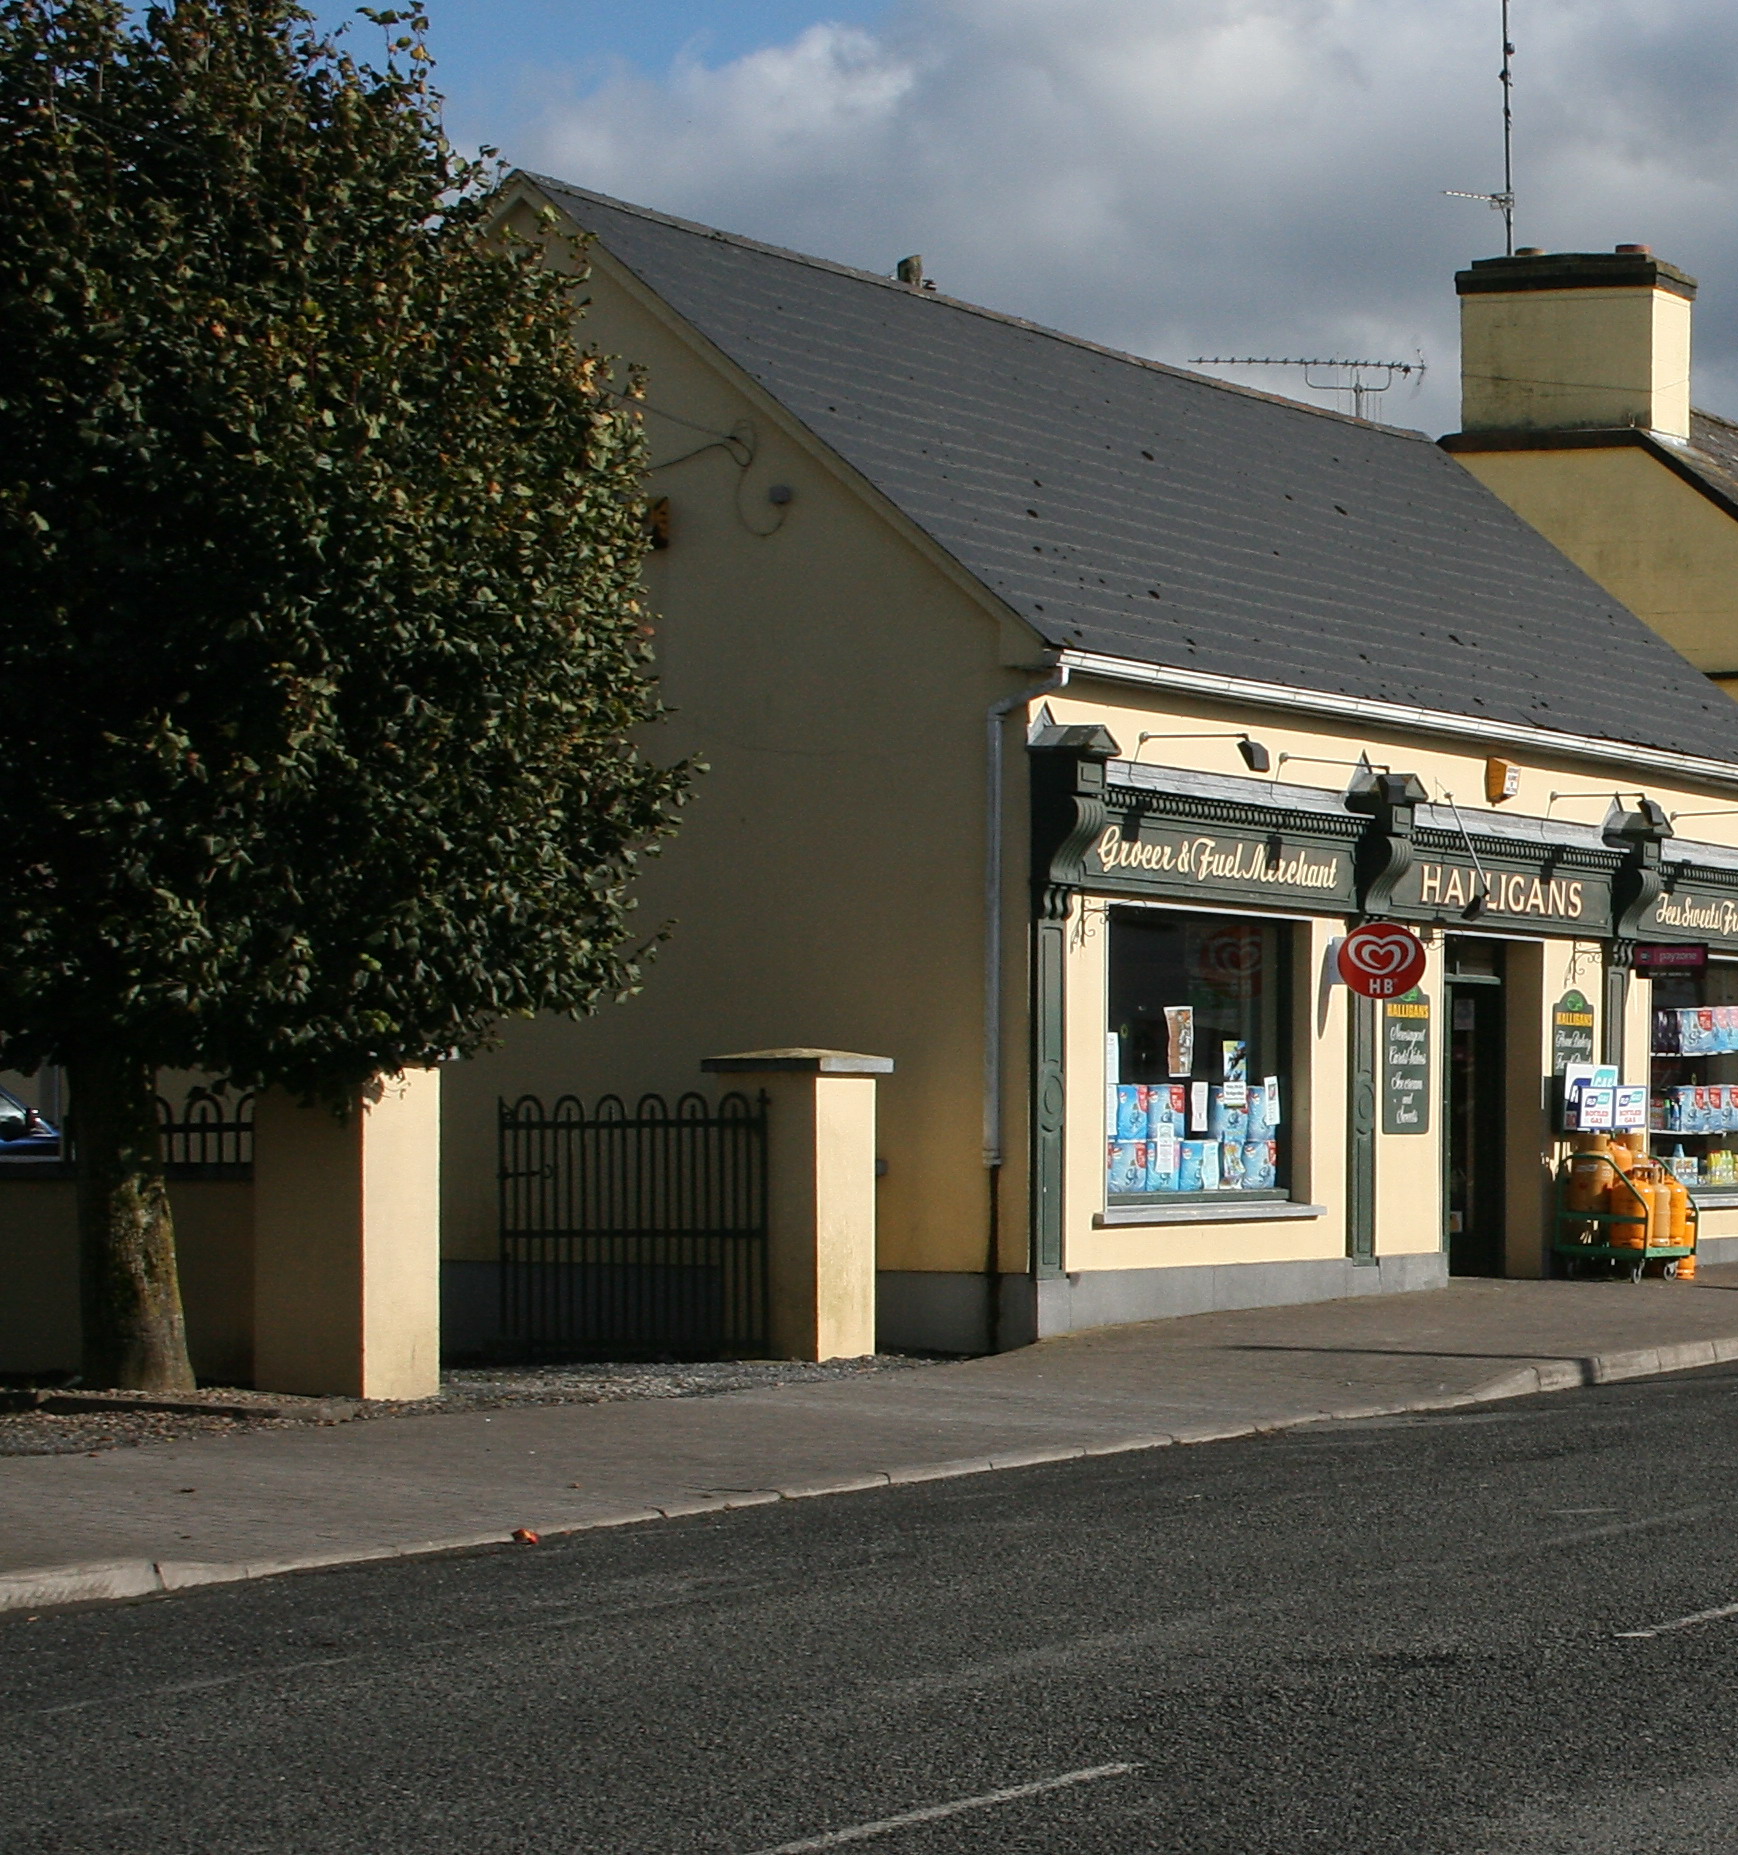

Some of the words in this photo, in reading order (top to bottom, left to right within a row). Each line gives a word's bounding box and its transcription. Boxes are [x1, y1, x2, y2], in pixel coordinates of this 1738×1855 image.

[1097, 825, 1176, 873] Grocer
[1177, 840, 1190, 873] &
[1190, 837, 1243, 881] Fuel
[1242, 843, 1338, 889] Merchant
[1420, 864, 1583, 919] HALLIGANS
[1681, 896, 1721, 930] Sweets
[1659, 952, 1697, 963] payzone
[1368, 978, 1394, 995] HB
[1386, 1004, 1429, 1018] HALLIGANS
[1556, 1011, 1593, 1026] HALLIGANS
